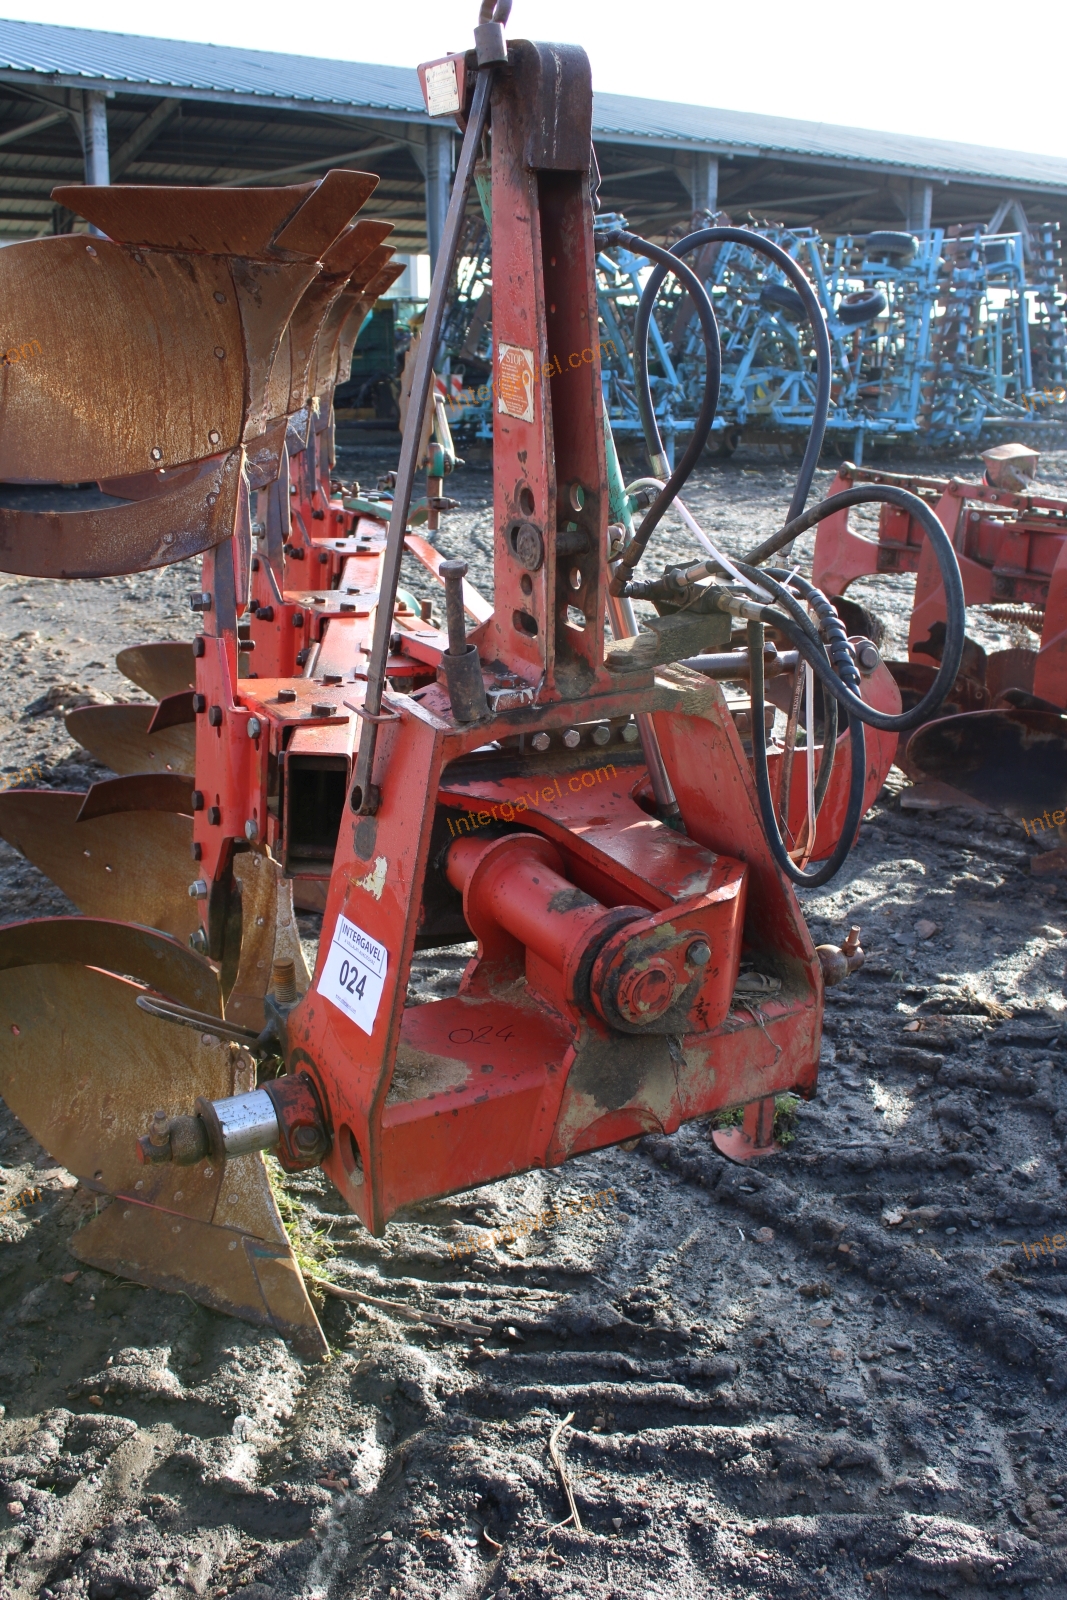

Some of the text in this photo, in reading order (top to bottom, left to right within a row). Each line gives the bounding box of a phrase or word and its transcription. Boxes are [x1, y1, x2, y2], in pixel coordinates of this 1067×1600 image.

[342, 923, 380, 961] INTERGAVEL
[339, 960, 367, 1001] 024
[449, 1025, 515, 1044] 024
